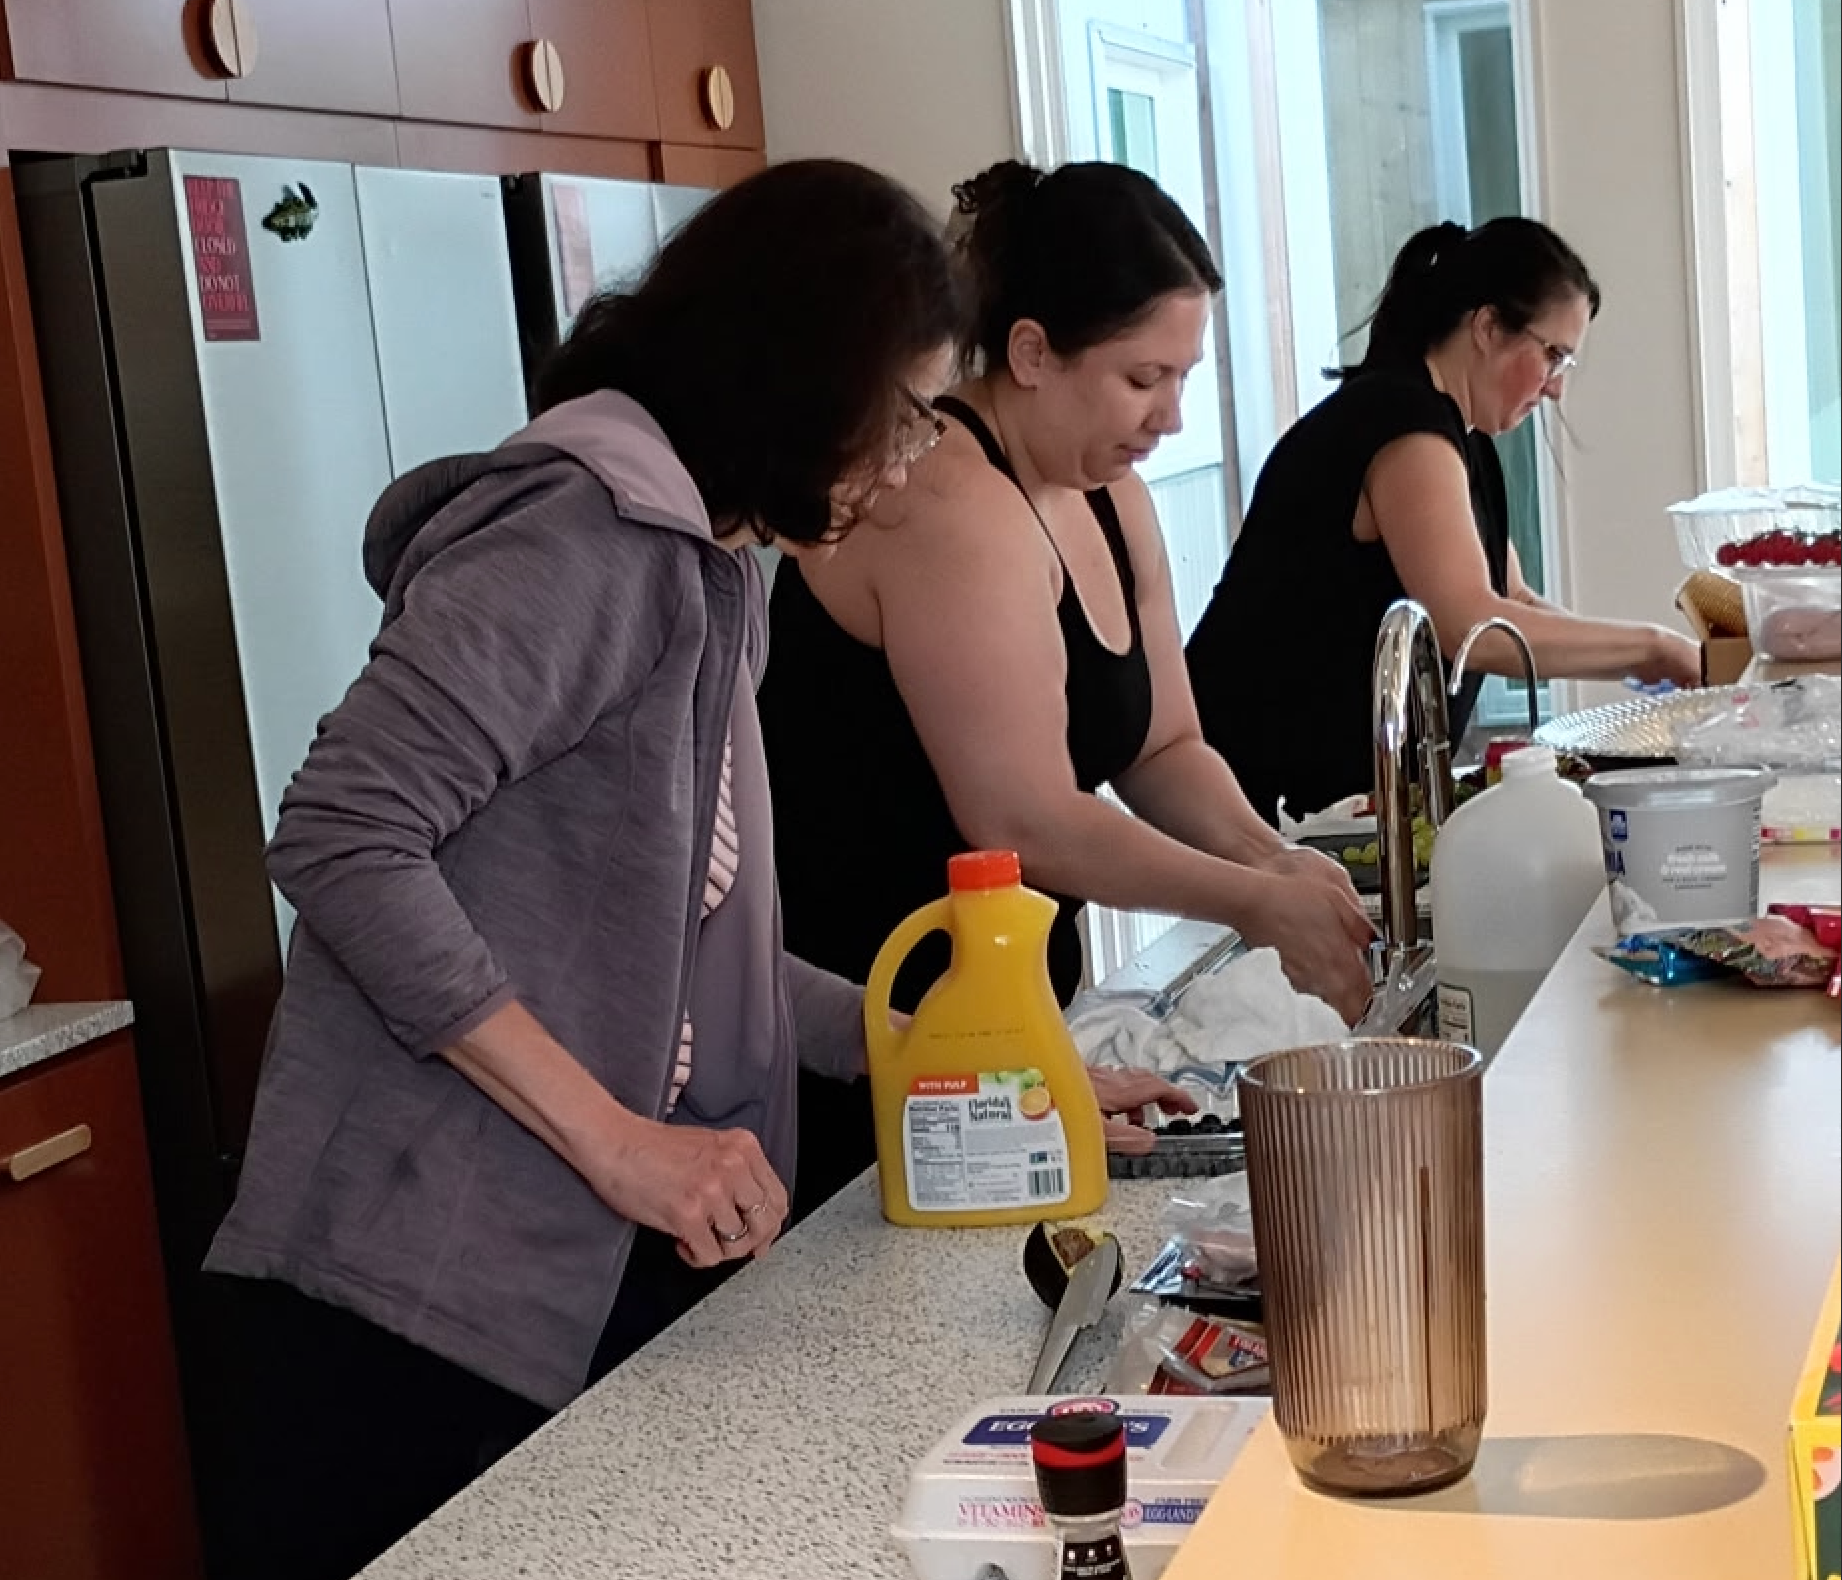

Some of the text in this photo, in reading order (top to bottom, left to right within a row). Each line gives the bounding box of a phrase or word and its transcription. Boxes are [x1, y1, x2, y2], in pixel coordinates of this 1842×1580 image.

[918, 1079, 968, 1090] WITH PULP
[968, 1096, 1012, 1110] Florida's
[968, 1109, 1012, 1121] Natural
